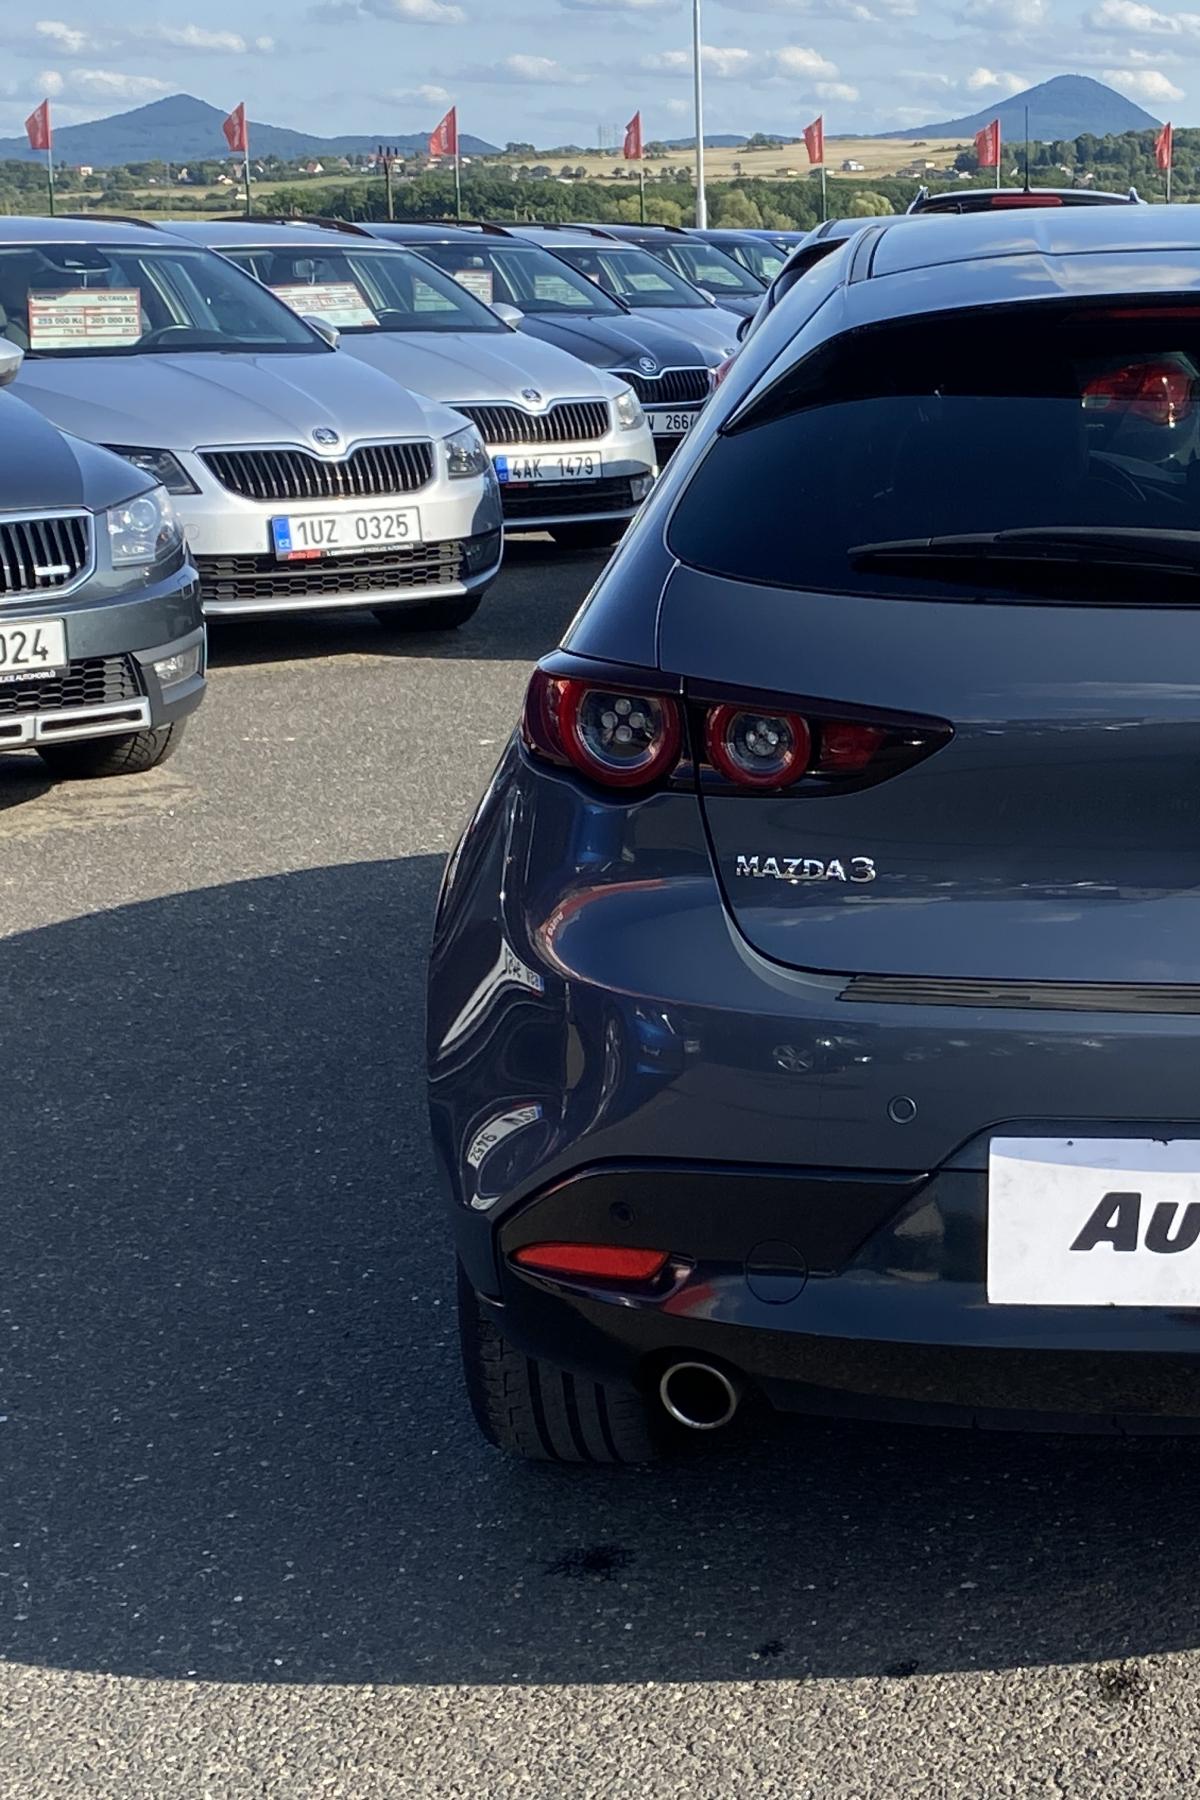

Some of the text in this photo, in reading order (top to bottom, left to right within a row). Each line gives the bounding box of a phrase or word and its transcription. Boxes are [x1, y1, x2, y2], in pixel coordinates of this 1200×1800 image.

[512, 459, 543, 479] 4AK
[557, 456, 594, 477] 1479
[297, 519, 339, 545] 1UZ
[355, 513, 409, 541] 0325
